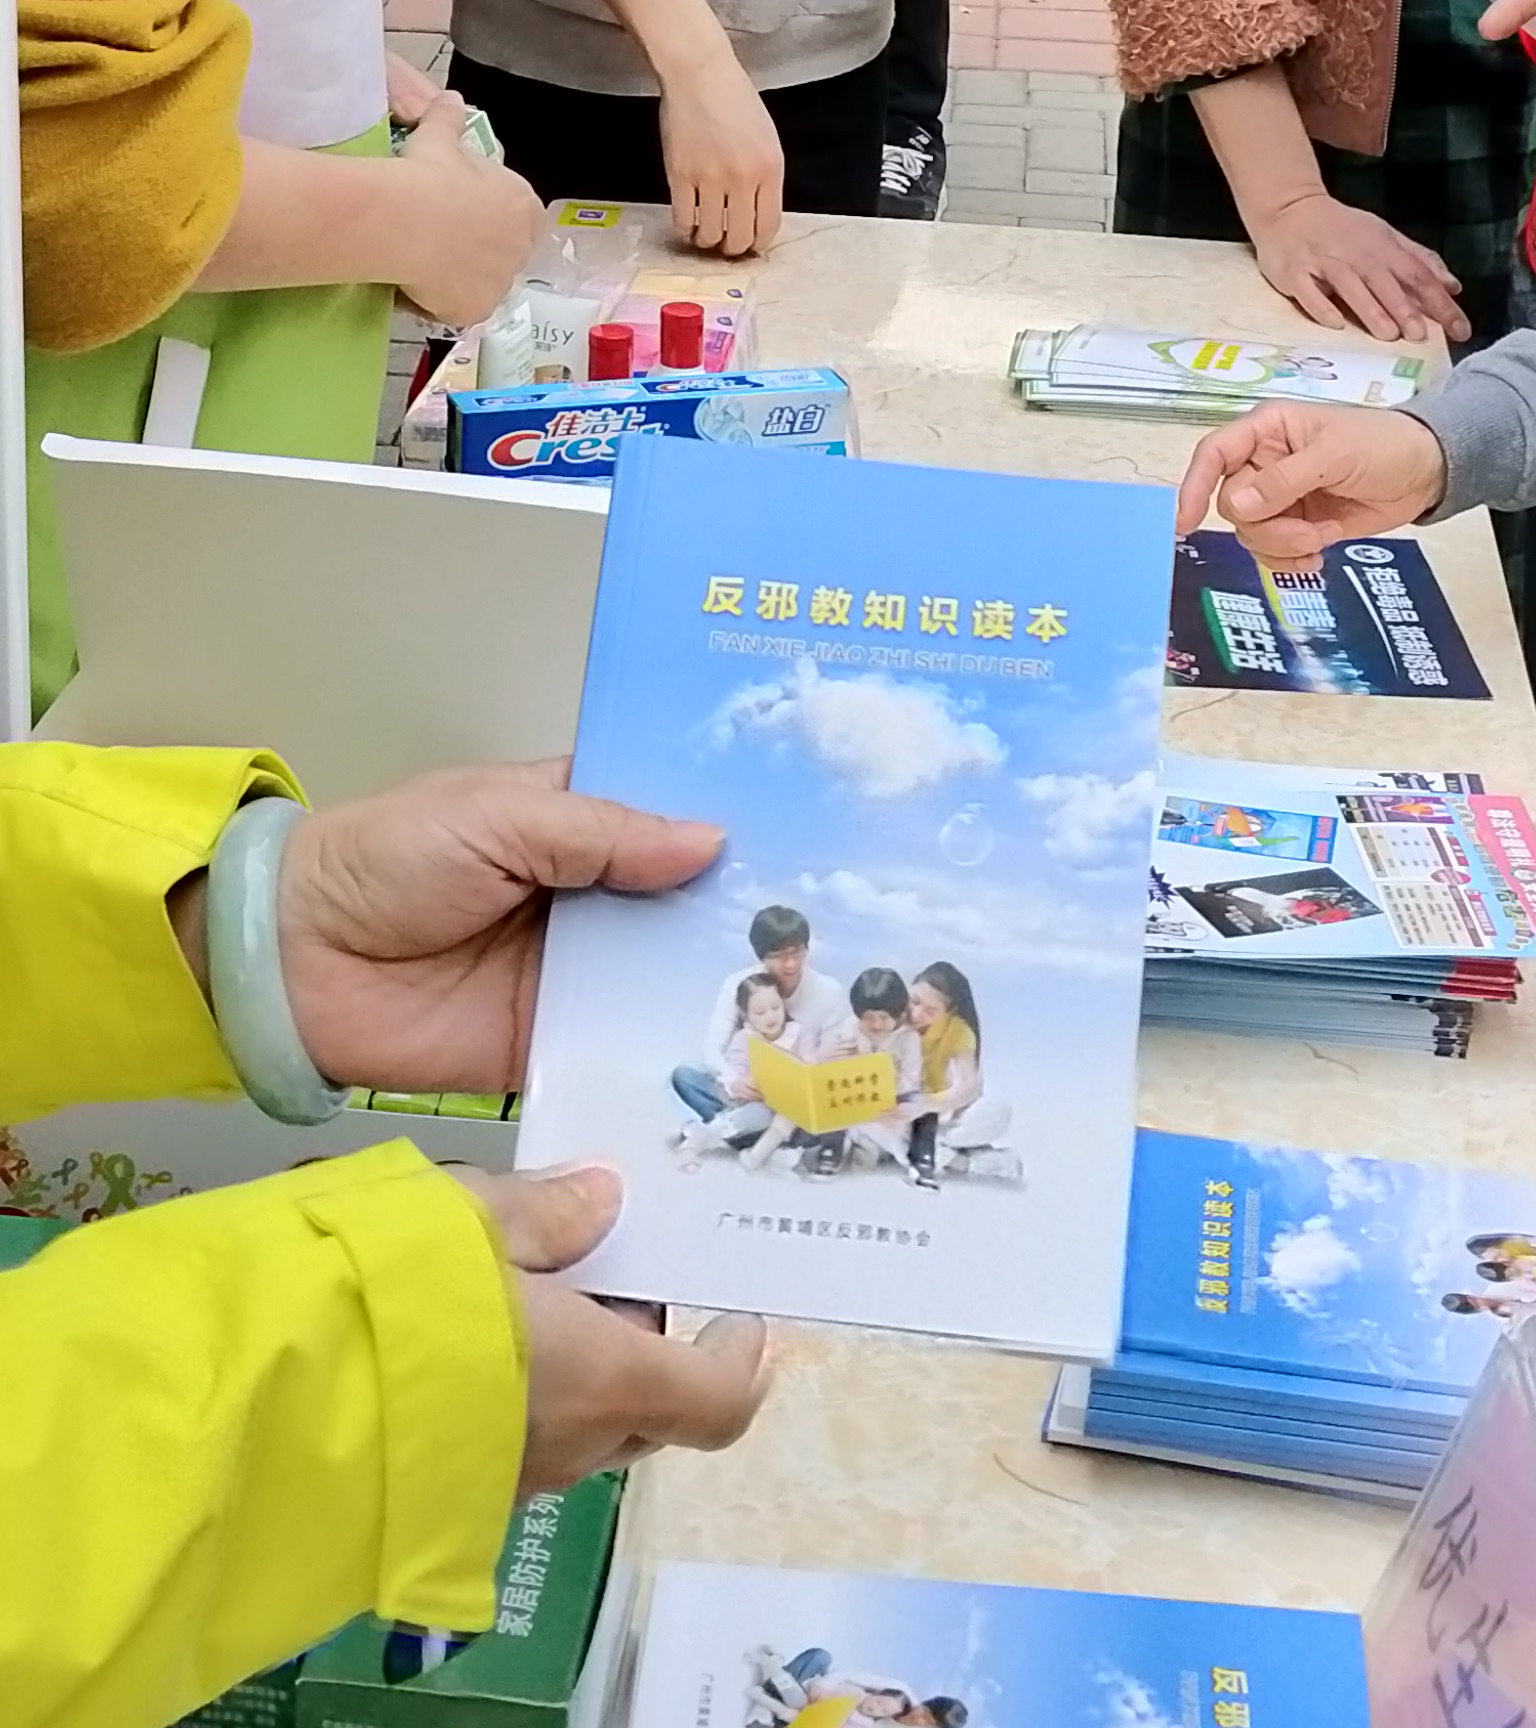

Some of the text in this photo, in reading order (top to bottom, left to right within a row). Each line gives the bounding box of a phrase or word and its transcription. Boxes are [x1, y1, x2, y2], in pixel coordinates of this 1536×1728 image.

[546, 405, 646, 440] 佳洁士
[762, 404, 825, 437] 盐白
[701, 574, 1069, 645] 反邪教知识读本
[1210, 590, 1288, 675] 健康生活
[1362, 567, 1449, 687] 拒绝毒品 抵制诱惑
[709, 630, 761, 656] FAN
[867, 647, 911, 669] ZHI
[914, 651, 954, 672] SHI
[960, 654, 996, 674] DU
[1000, 657, 1055, 680] BEN
[717, 1212, 931, 1247] 广州市黄埔区反邪教协会
[1195, 1178, 1235, 1315] 反邪教知识读本
[496, 1492, 565, 1638] 家居防护系列
[1211, 1666, 1250, 1728] 反邪
